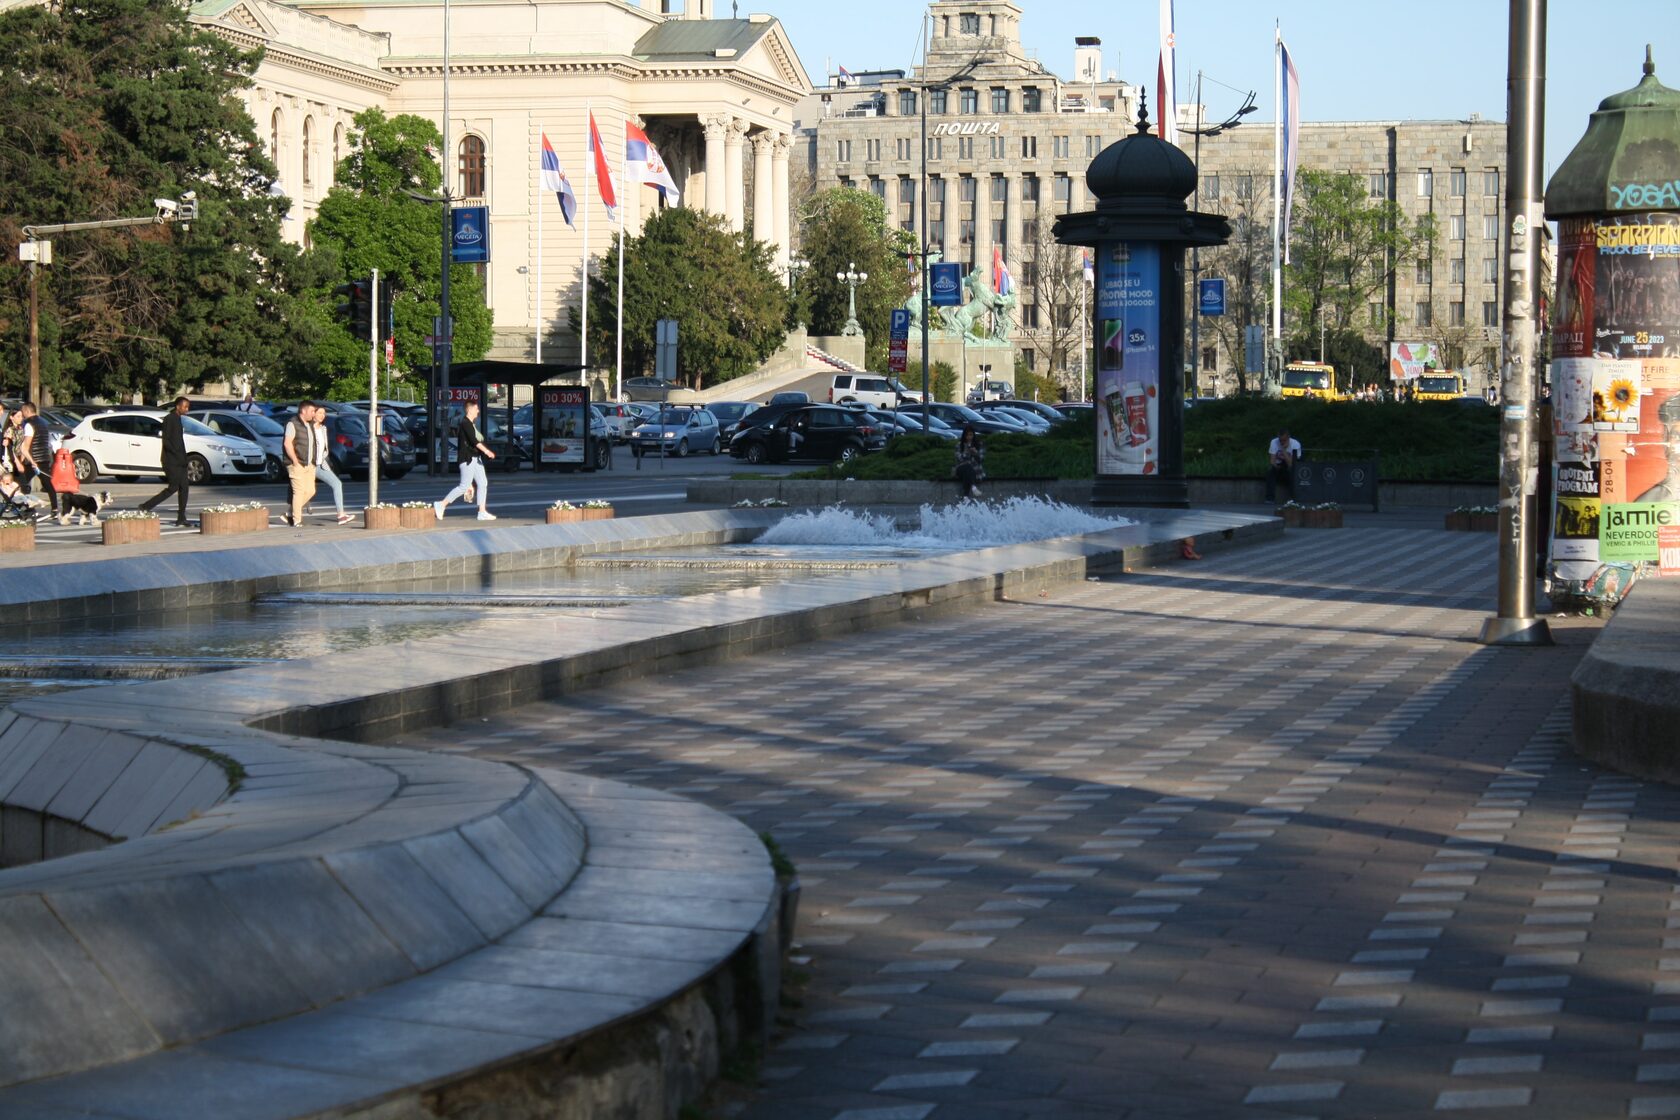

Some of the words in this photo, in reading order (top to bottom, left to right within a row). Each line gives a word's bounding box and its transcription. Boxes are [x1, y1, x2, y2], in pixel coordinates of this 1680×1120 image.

[934, 122, 1000, 135] ПОШТА
[894, 312, 905, 328] P
[1129, 334, 1145, 343] 35x
[1620, 336, 1636, 344] JUNE
[1636, 331, 1649, 344] 25
[1649, 336, 1665, 344] 2023
[456, 389, 479, 400] 30%
[544, 393, 558, 403] DO
[561, 392, 582, 403] 30%
[1558, 481, 1599, 493] PROGRAM
[1606, 504, 1672, 530] jamie
